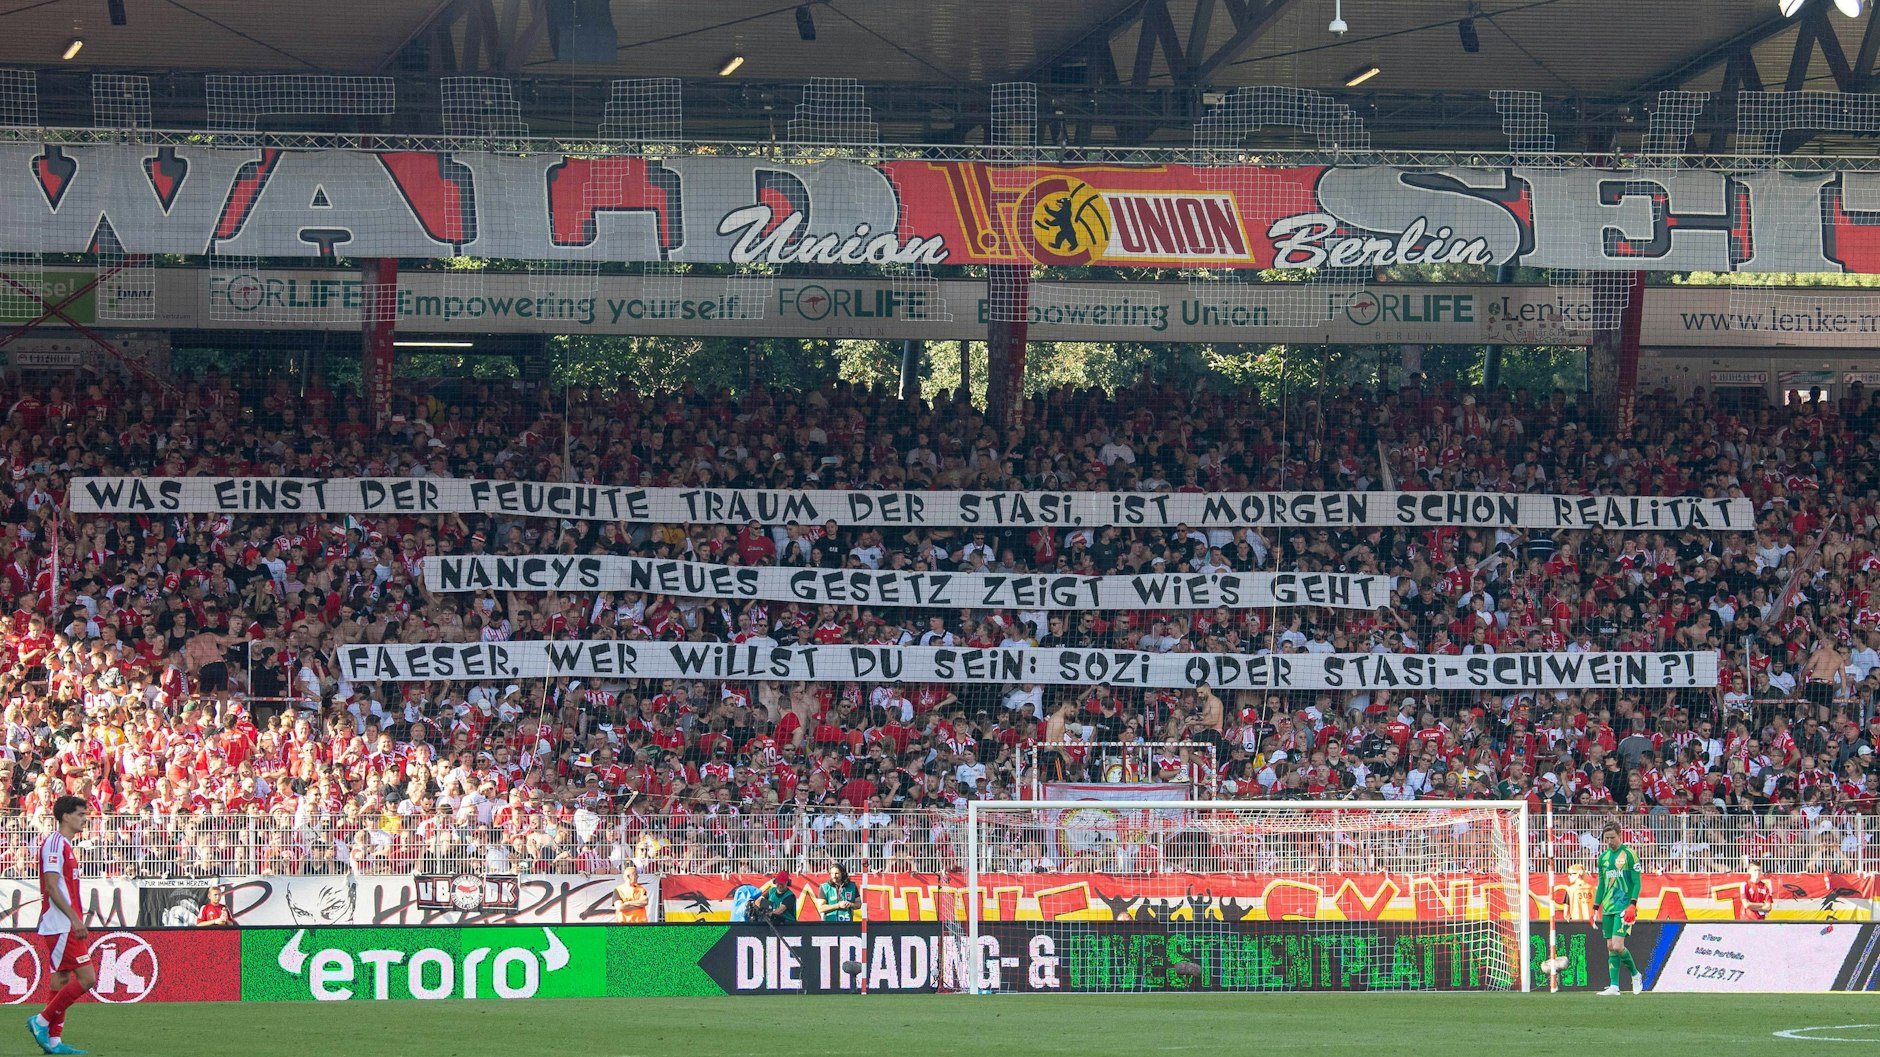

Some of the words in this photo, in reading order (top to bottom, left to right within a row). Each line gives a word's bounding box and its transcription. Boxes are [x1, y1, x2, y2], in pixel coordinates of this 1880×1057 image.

[716, 203, 950, 265] Union
[1108, 197, 1250, 255] UNION
[1267, 213, 1493, 269] Berlin
[398, 289, 598, 326] Empowering
[607, 294, 747, 331] yourself.
[779, 284, 927, 321] FORLIFE
[1181, 299, 1280, 327] Union.
[1328, 290, 1474, 326] FORLIFE
[1501, 296, 1591, 321] Lenke
[826, 327, 885, 337] BERLIN
[1375, 331, 1432, 341] BERLIN
[86, 479, 182, 510] WAS
[360, 480, 438, 510] DER
[470, 482, 649, 519] FEUCHTE
[680, 490, 819, 522] TRAUM
[848, 493, 925, 523] DER
[1202, 494, 1367, 524] MORGEN
[1397, 495, 1519, 525] SCHON
[631, 561, 759, 596] NEUES
[791, 573, 952, 604] GESETZ
[1271, 575, 1374, 607] GEHT
[348, 647, 519, 679] FAESER,
[545, 643, 637, 674] WER
[850, 648, 902, 678] DU
[1185, 656, 1291, 687] ODER
[736, 935, 803, 990] DIE
[1029, 935, 1061, 989] &
